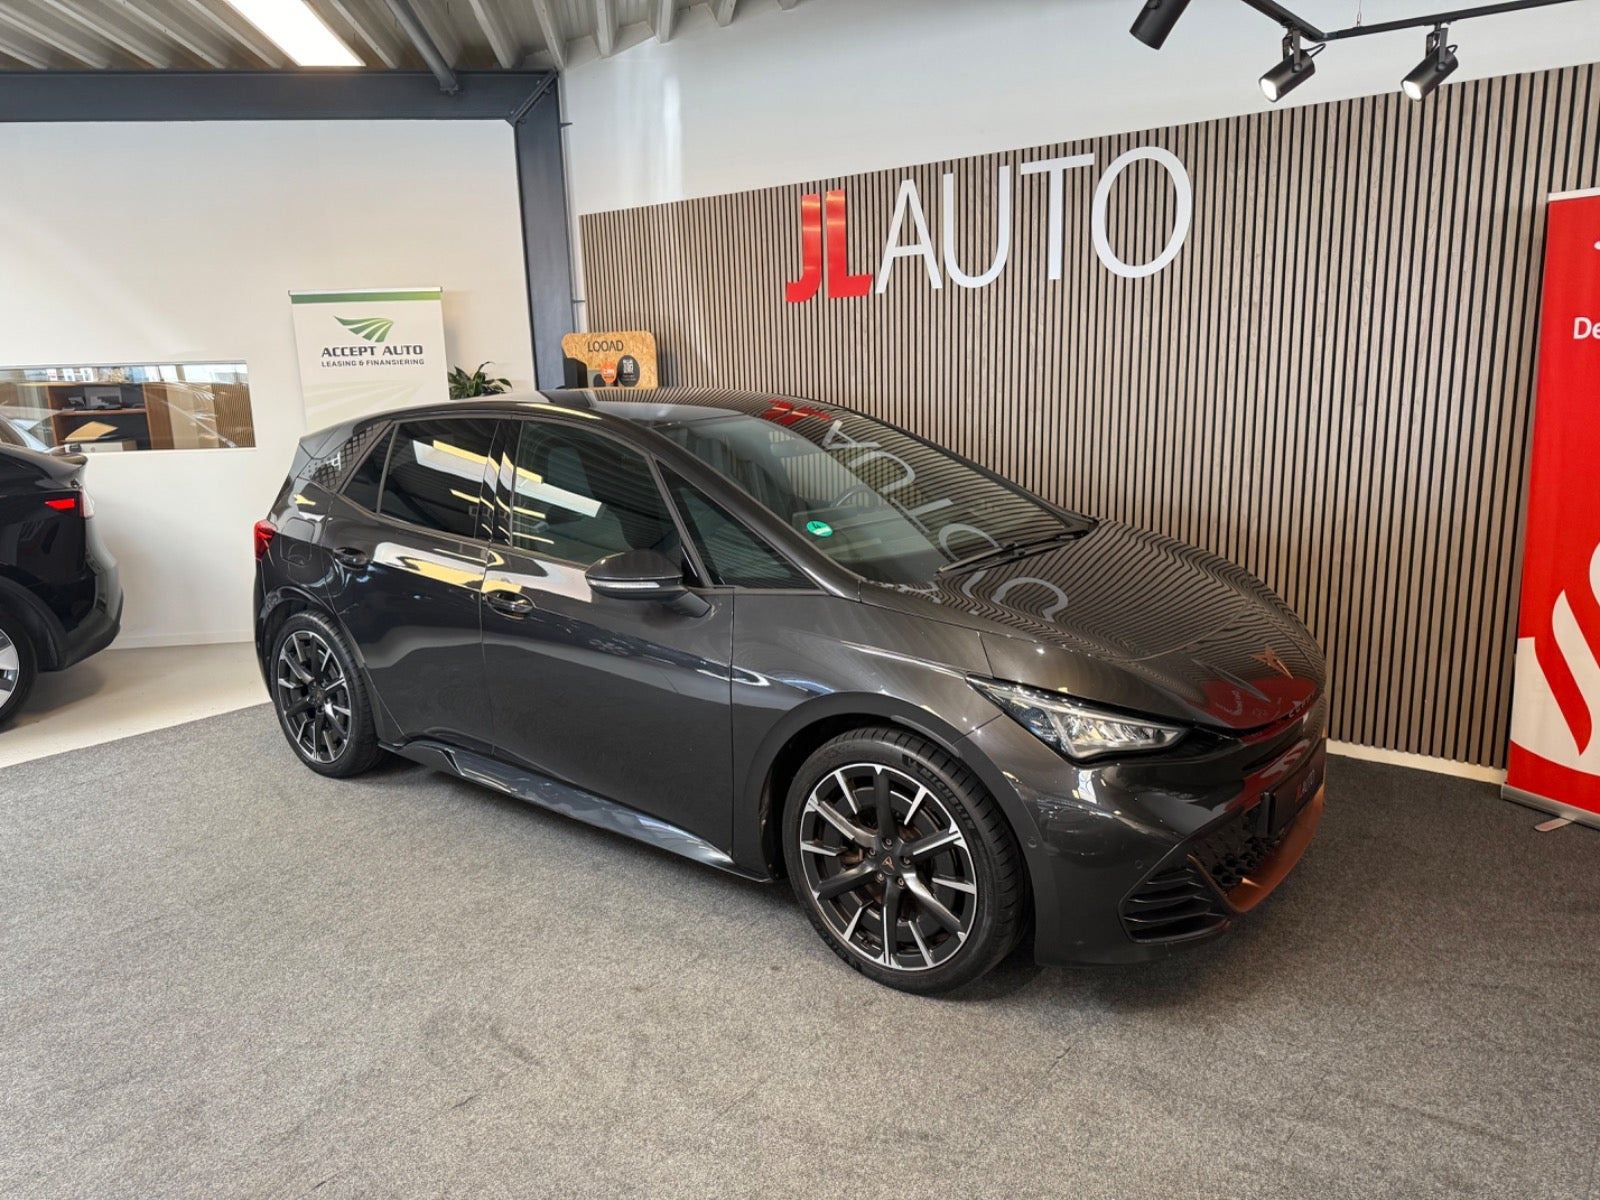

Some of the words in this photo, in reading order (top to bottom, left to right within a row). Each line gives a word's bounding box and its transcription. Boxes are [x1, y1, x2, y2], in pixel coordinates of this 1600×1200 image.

[321, 345, 377, 357] ACCEPT
[382, 344, 424, 355] AUTO
[588, 340, 624, 352] LOOAD
[366, 358, 425, 366] FINANSIERING
